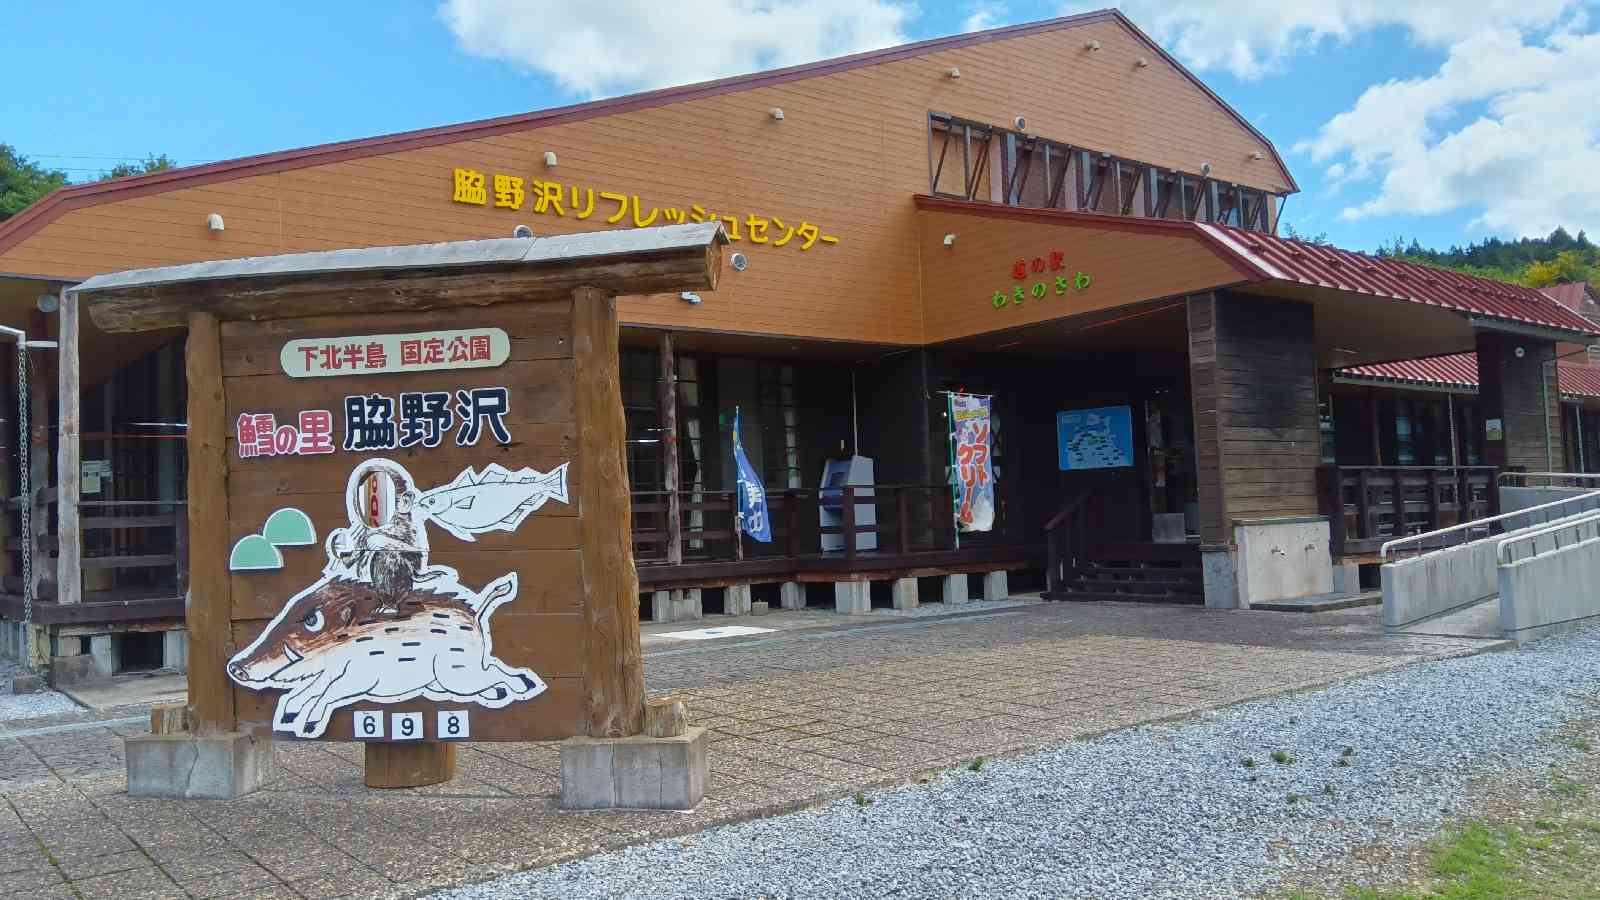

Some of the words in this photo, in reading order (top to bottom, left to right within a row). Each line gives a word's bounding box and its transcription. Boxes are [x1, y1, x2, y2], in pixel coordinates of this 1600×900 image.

[453, 167, 840, 250] 脇野沢リフレッシュセンター
[992, 271, 1091, 309] わきのさわ
[298, 341, 388, 372] 下北半島
[400, 335, 491, 365] 国定公園
[237, 410, 335, 457] 鱈の里
[342, 387, 511, 451] 脇野沢
